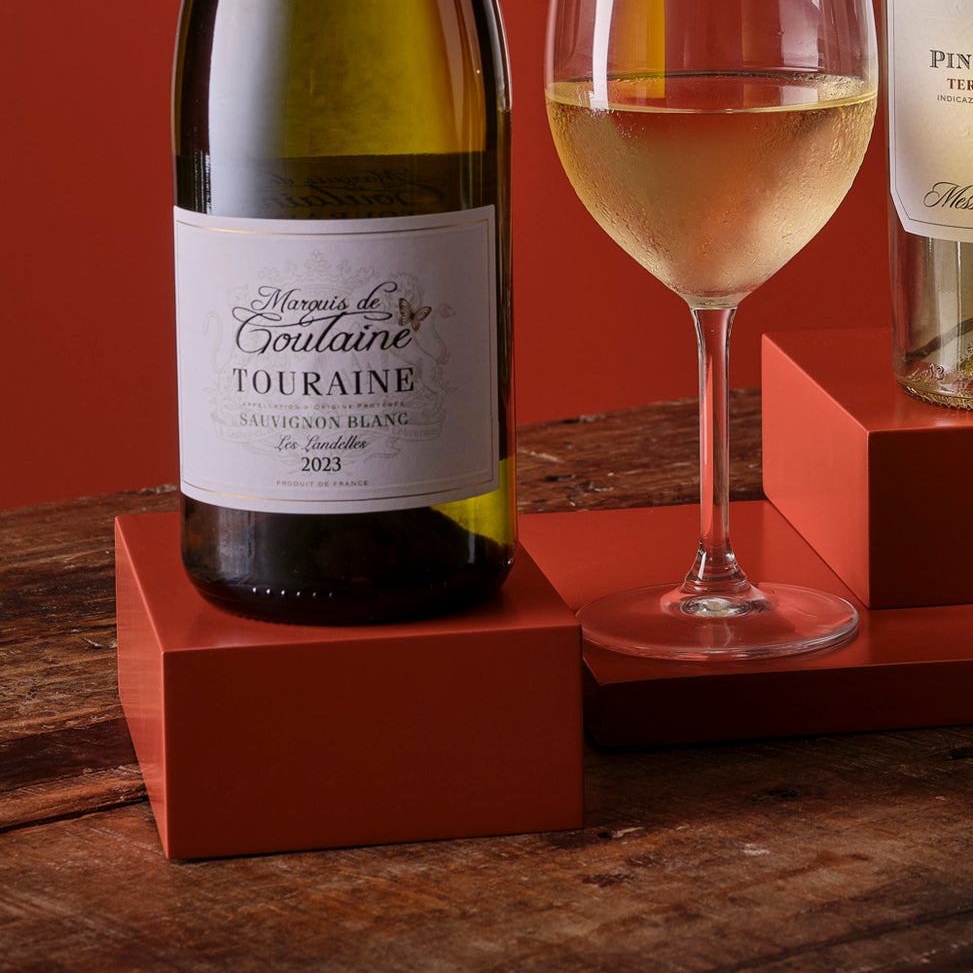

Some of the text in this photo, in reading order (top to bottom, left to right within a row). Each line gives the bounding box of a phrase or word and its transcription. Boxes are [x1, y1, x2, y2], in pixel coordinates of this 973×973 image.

[251, 281, 398, 327] Marquis de
[232, 366, 415, 397] TOURAINE
[239, 412, 409, 429] SAUVIGNON BLANC
[274, 434, 369, 453] Les Landelles
[300, 456, 342, 472] 2023
